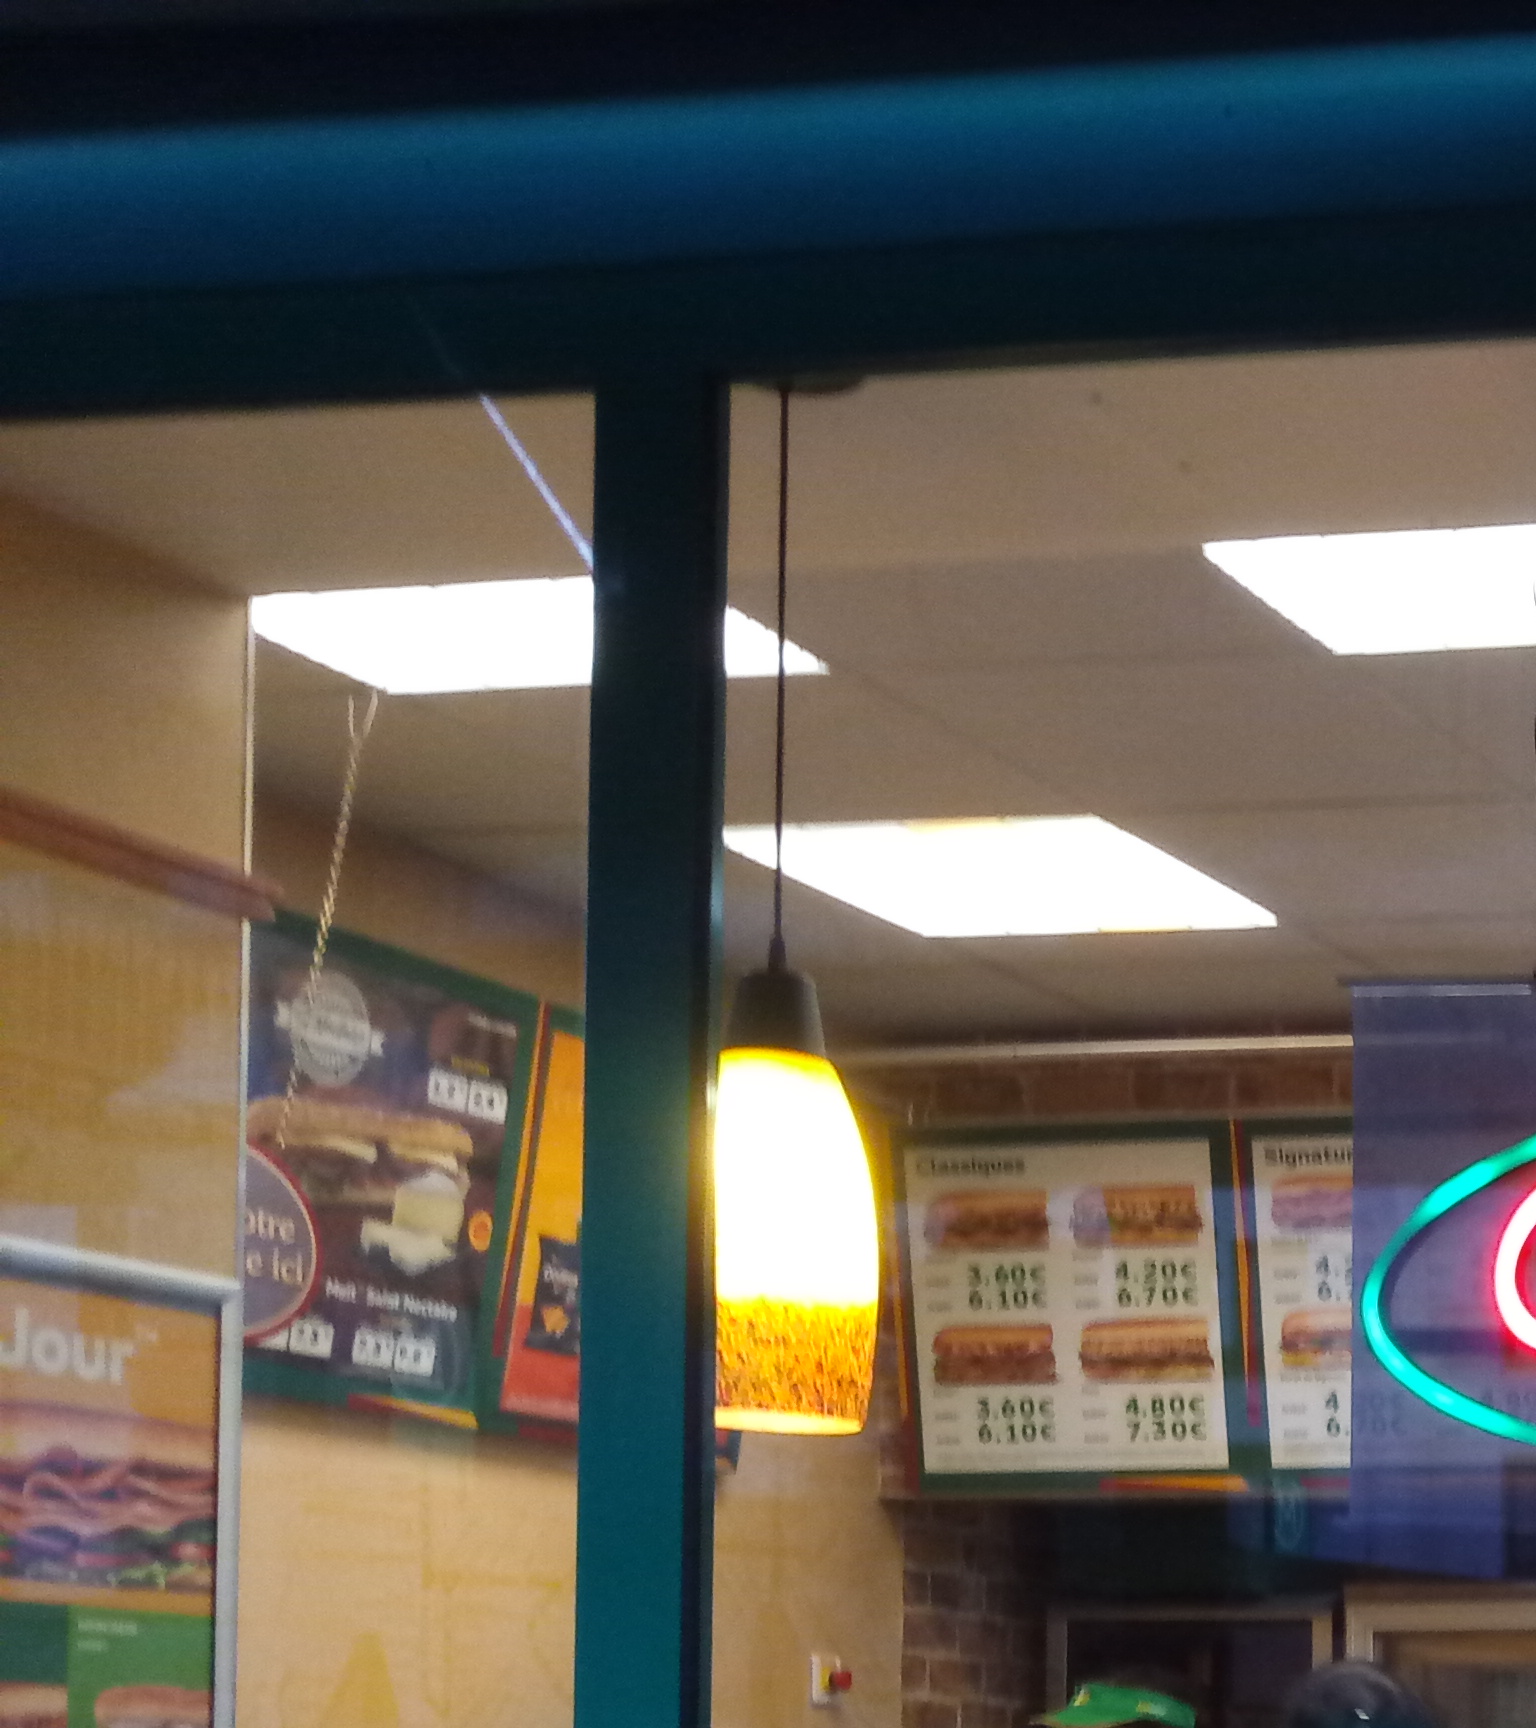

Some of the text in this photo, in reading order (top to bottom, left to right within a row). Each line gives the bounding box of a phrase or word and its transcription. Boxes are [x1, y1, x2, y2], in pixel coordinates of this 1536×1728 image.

[968, 1288, 1048, 1311] 6.10€
[1117, 1286, 1199, 1309] 6.70€
[978, 1422, 1056, 1446] 6.10€
[1126, 1420, 1208, 1443] 7.30€
